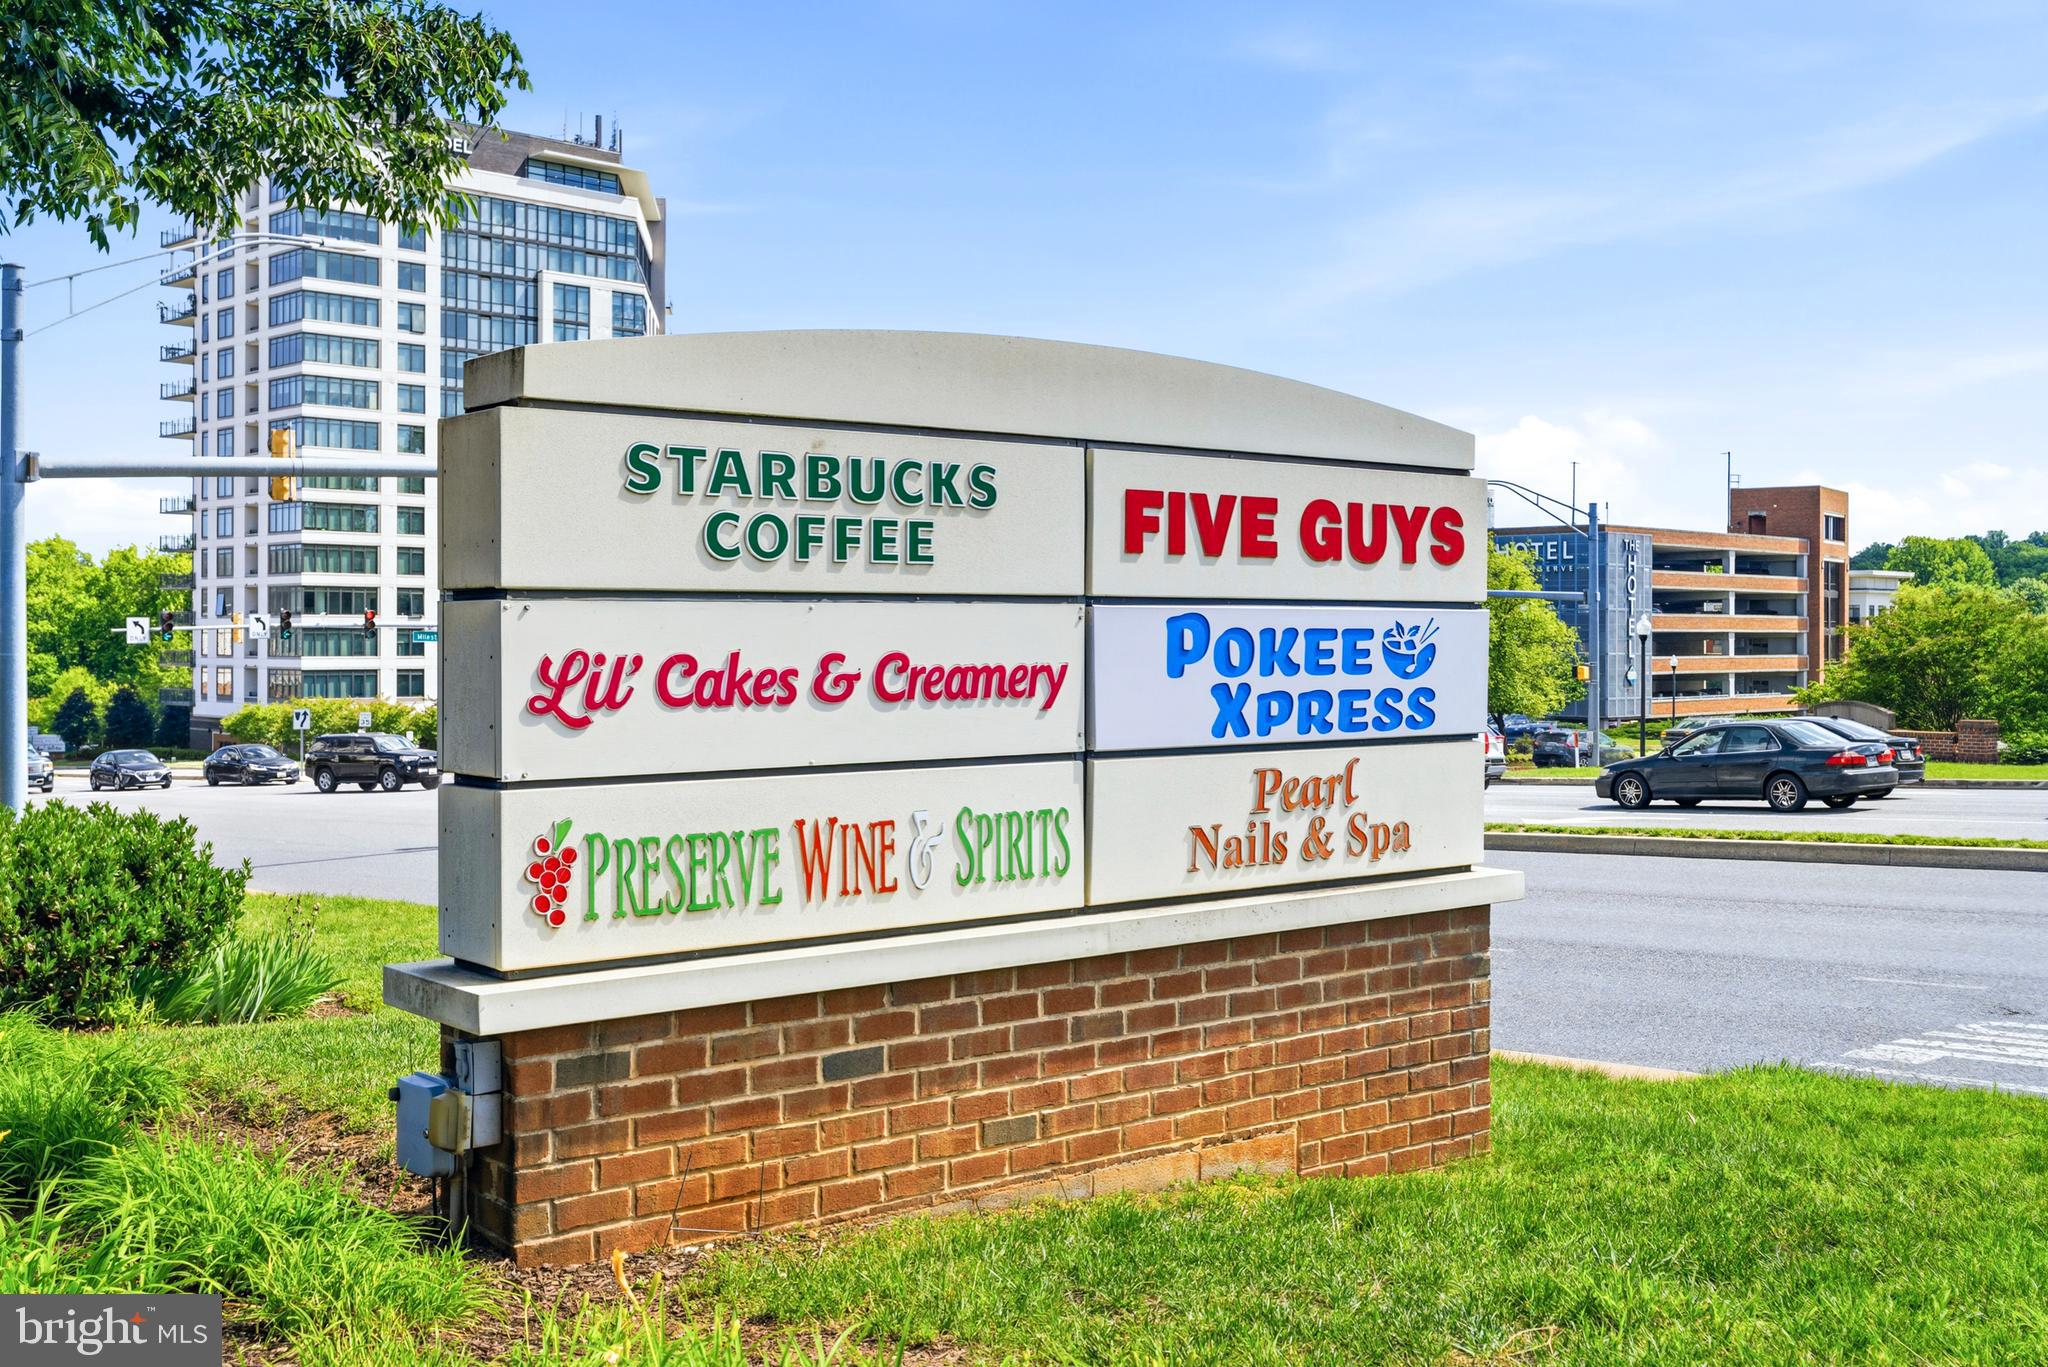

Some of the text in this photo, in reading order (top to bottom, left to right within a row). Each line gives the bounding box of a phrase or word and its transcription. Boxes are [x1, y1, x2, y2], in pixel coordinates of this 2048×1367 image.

[625, 441, 998, 510] STARBUCKS
[704, 509, 936, 565] COFFEE
[1125, 489, 1465, 566] FIVE GUYS
[1495, 540, 1574, 561] HOTEL
[1623, 538, 1641, 552] THE
[1627, 554, 1637, 658] HOTEL
[1166, 612, 1375, 679] POKEE
[655, 649, 799, 708] Cakes
[811, 651, 862, 703] &
[873, 650, 1069, 711] Creamery
[1210, 682, 1436, 739] XPRESS
[1250, 757, 1361, 814] Pearl
[583, 806, 1071, 921] PRESERVE WINE & SPIRITS
[1186, 811, 1412, 873] Nails & Spa
